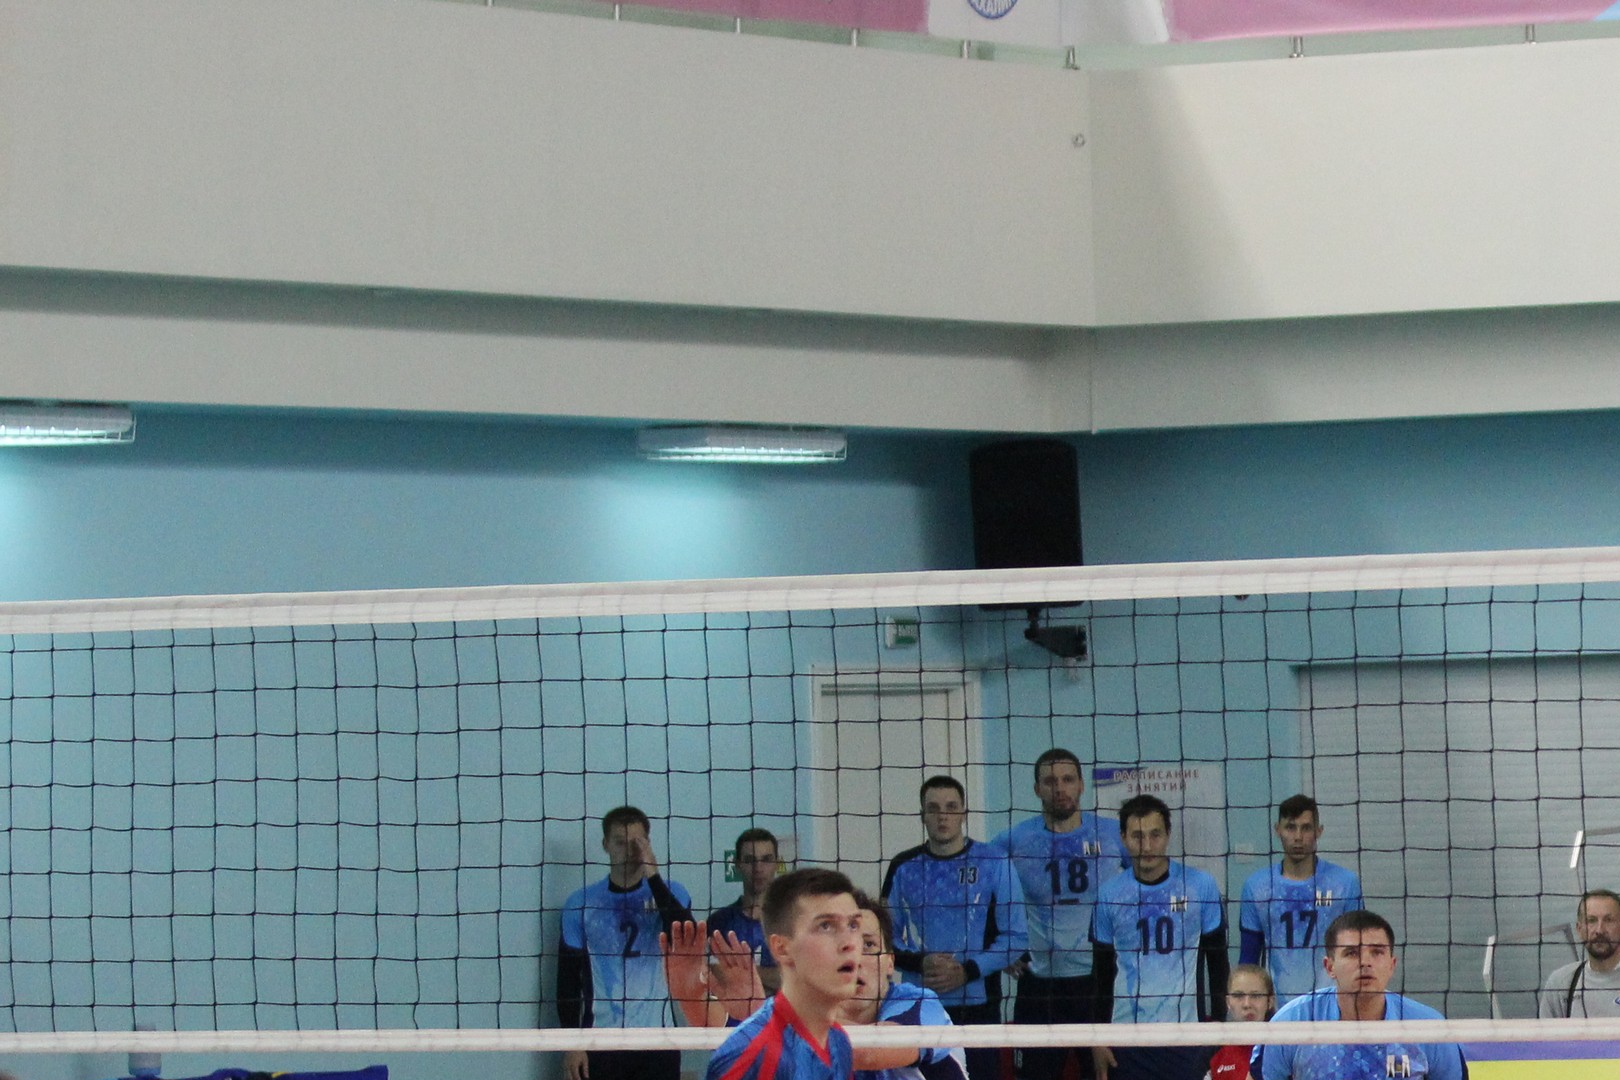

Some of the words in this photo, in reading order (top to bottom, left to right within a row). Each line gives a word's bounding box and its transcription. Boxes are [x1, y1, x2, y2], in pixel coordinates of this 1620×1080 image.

[1113, 769, 1200, 782] РАСПИСАНИЕ
[1127, 781, 1187, 793] ЗАНЯТИЙ
[958, 867, 978, 884] 13
[1045, 859, 1090, 895] 18
[619, 921, 641, 958] 2
[1136, 916, 1174, 955] 10
[1280, 910, 1318, 949] 17
